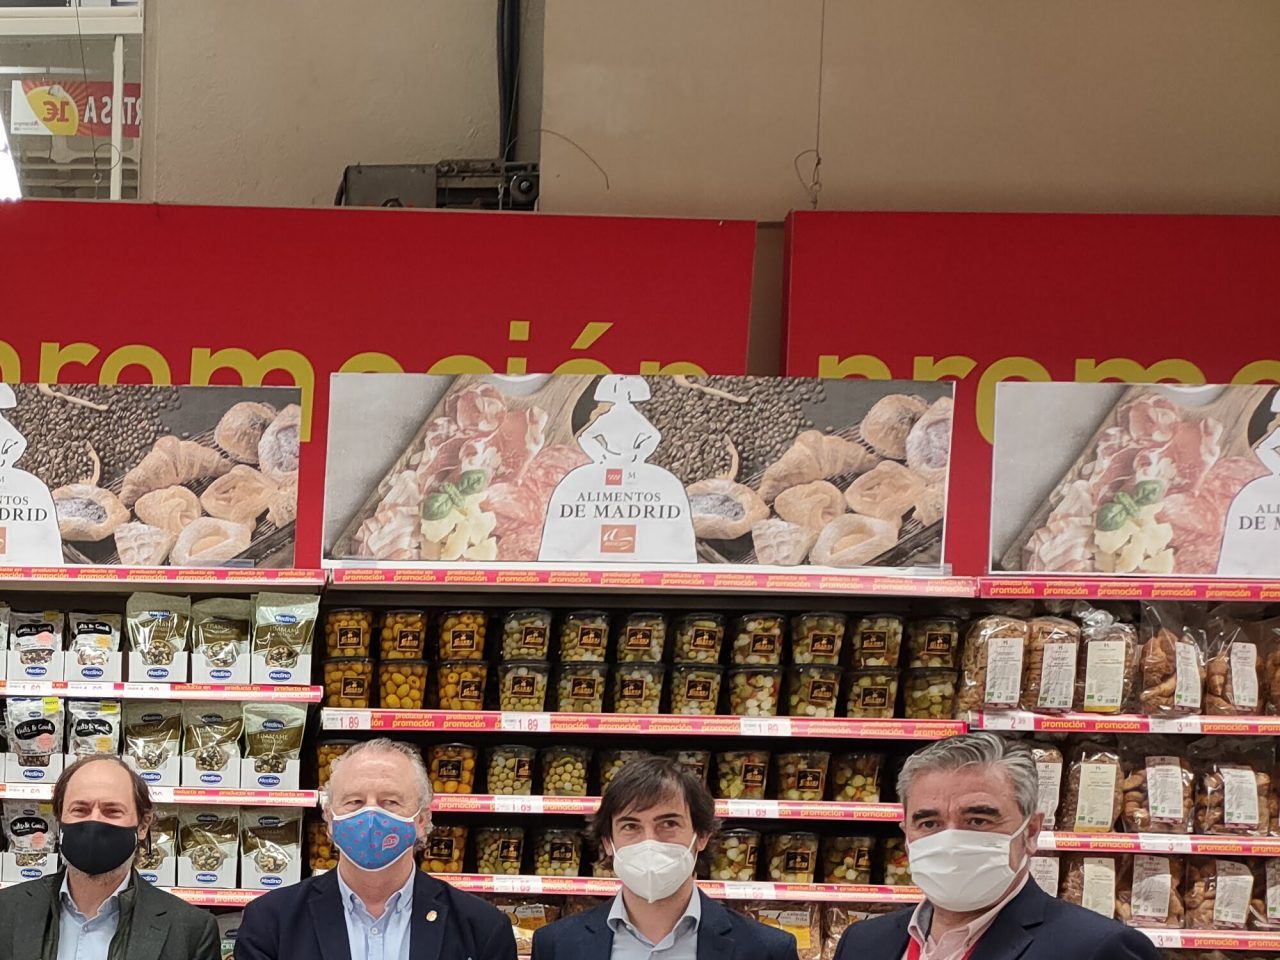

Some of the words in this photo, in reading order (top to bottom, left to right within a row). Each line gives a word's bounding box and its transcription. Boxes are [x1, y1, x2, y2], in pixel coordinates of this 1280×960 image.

[576, 492, 661, 503] ALIMENTOS
[559, 504, 585, 519] DE
[592, 504, 681, 519] MADRID
[1239, 516, 1266, 530] DE
[990, 586, 1035, 595] promoción
[1043, 587, 1088, 596] promoción
[1097, 588, 1142, 596] promoción
[1151, 588, 1196, 597] promoción
[1205, 589, 1251, 598] promoción
[339, 717, 360, 728] 1.89
[392, 719, 434, 727] promoción
[443, 719, 485, 728] promoción
[1041, 721, 1086, 730] promoción
[1095, 722, 1140, 730] promoción
[1203, 723, 1249, 732] promoción
[1090, 841, 1134, 850] promoción
[1197, 843, 1242, 852] promoción
